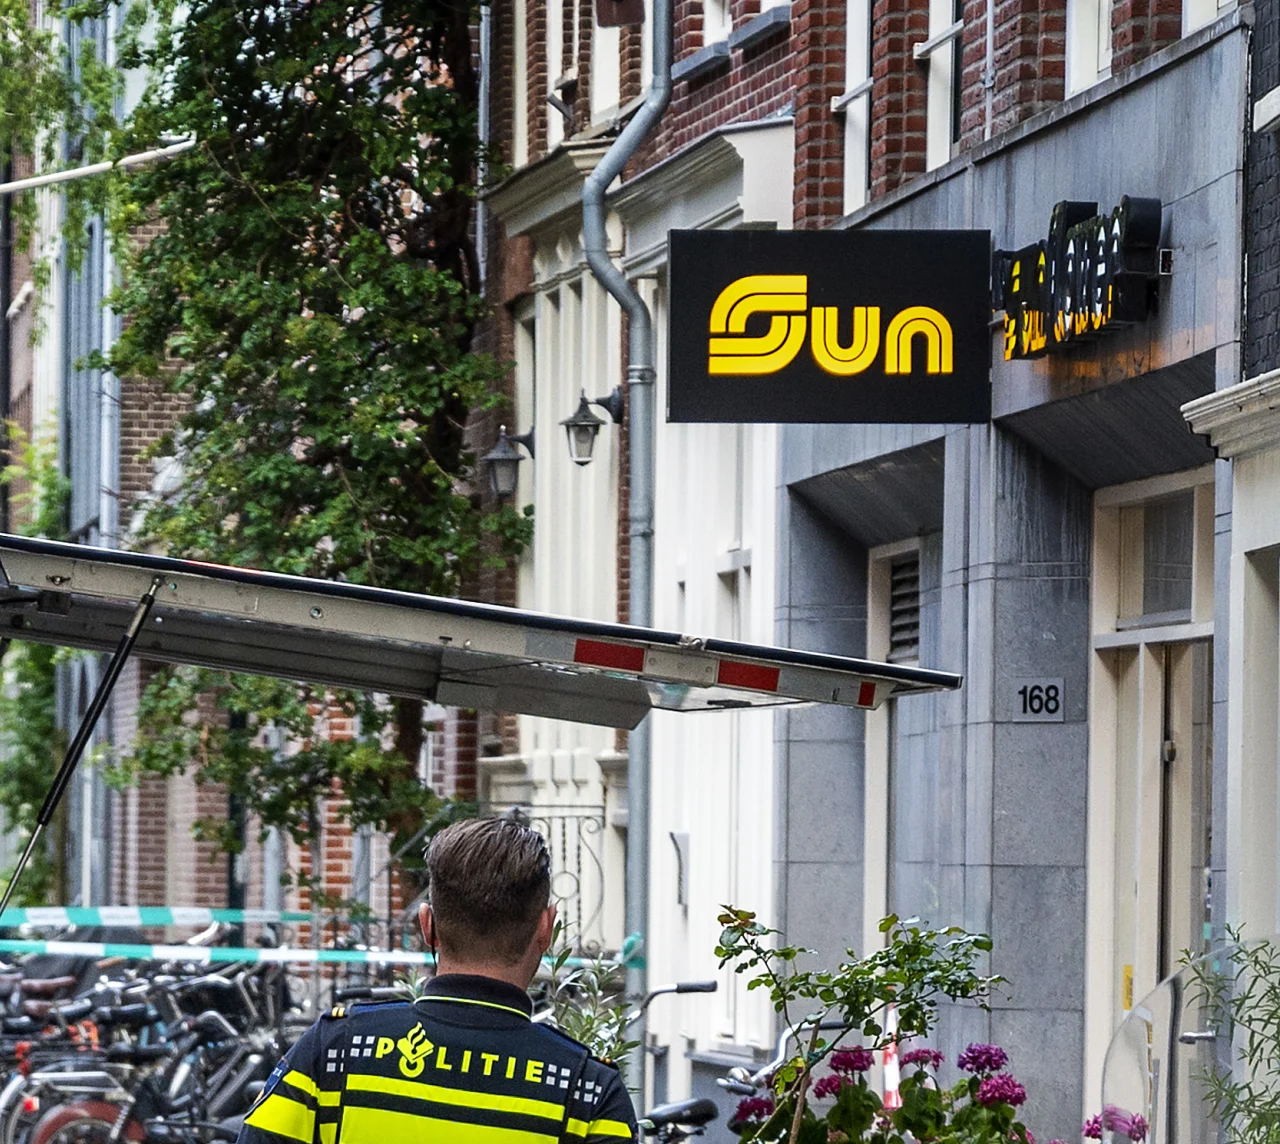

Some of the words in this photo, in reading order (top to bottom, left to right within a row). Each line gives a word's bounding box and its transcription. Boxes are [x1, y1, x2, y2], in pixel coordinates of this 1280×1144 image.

[708, 274, 953, 375] Sun
[1017, 684, 1060, 715] 168
[375, 1021, 545, 1083] POLITIE
